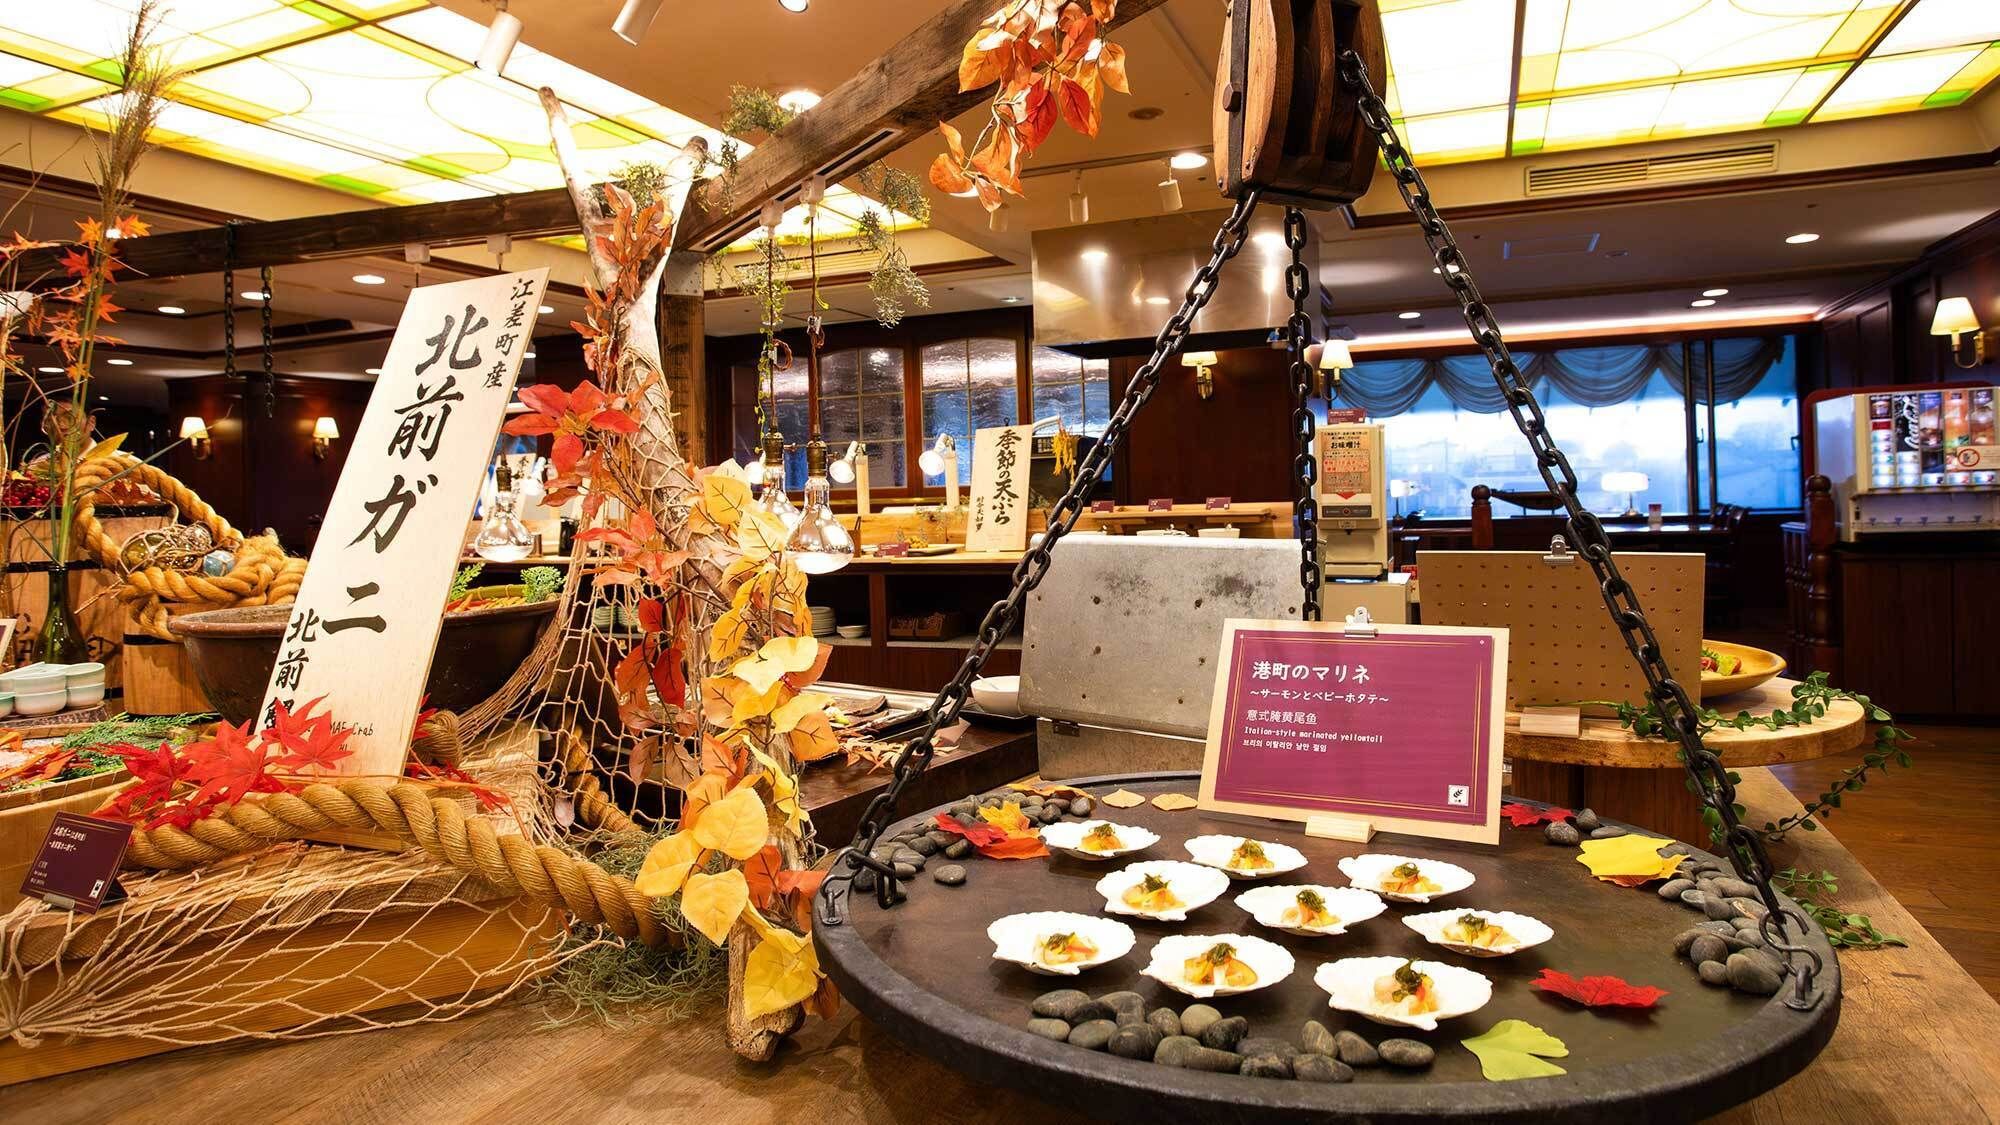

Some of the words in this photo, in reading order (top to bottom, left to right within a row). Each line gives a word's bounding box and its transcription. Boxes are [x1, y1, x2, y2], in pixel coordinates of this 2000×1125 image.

[482, 278, 534, 388] 江差町産
[322, 304, 488, 634] 北前ガニ
[992, 429, 1022, 525] 季節の天ぷら
[1251, 661, 1370, 684] 港町のマリネ
[352, 721, 374, 737] Crab
[1244, 726, 1296, 738] Italian-style
[1299, 730, 1337, 740] marinated
[1341, 733, 1383, 743] yellowtail
